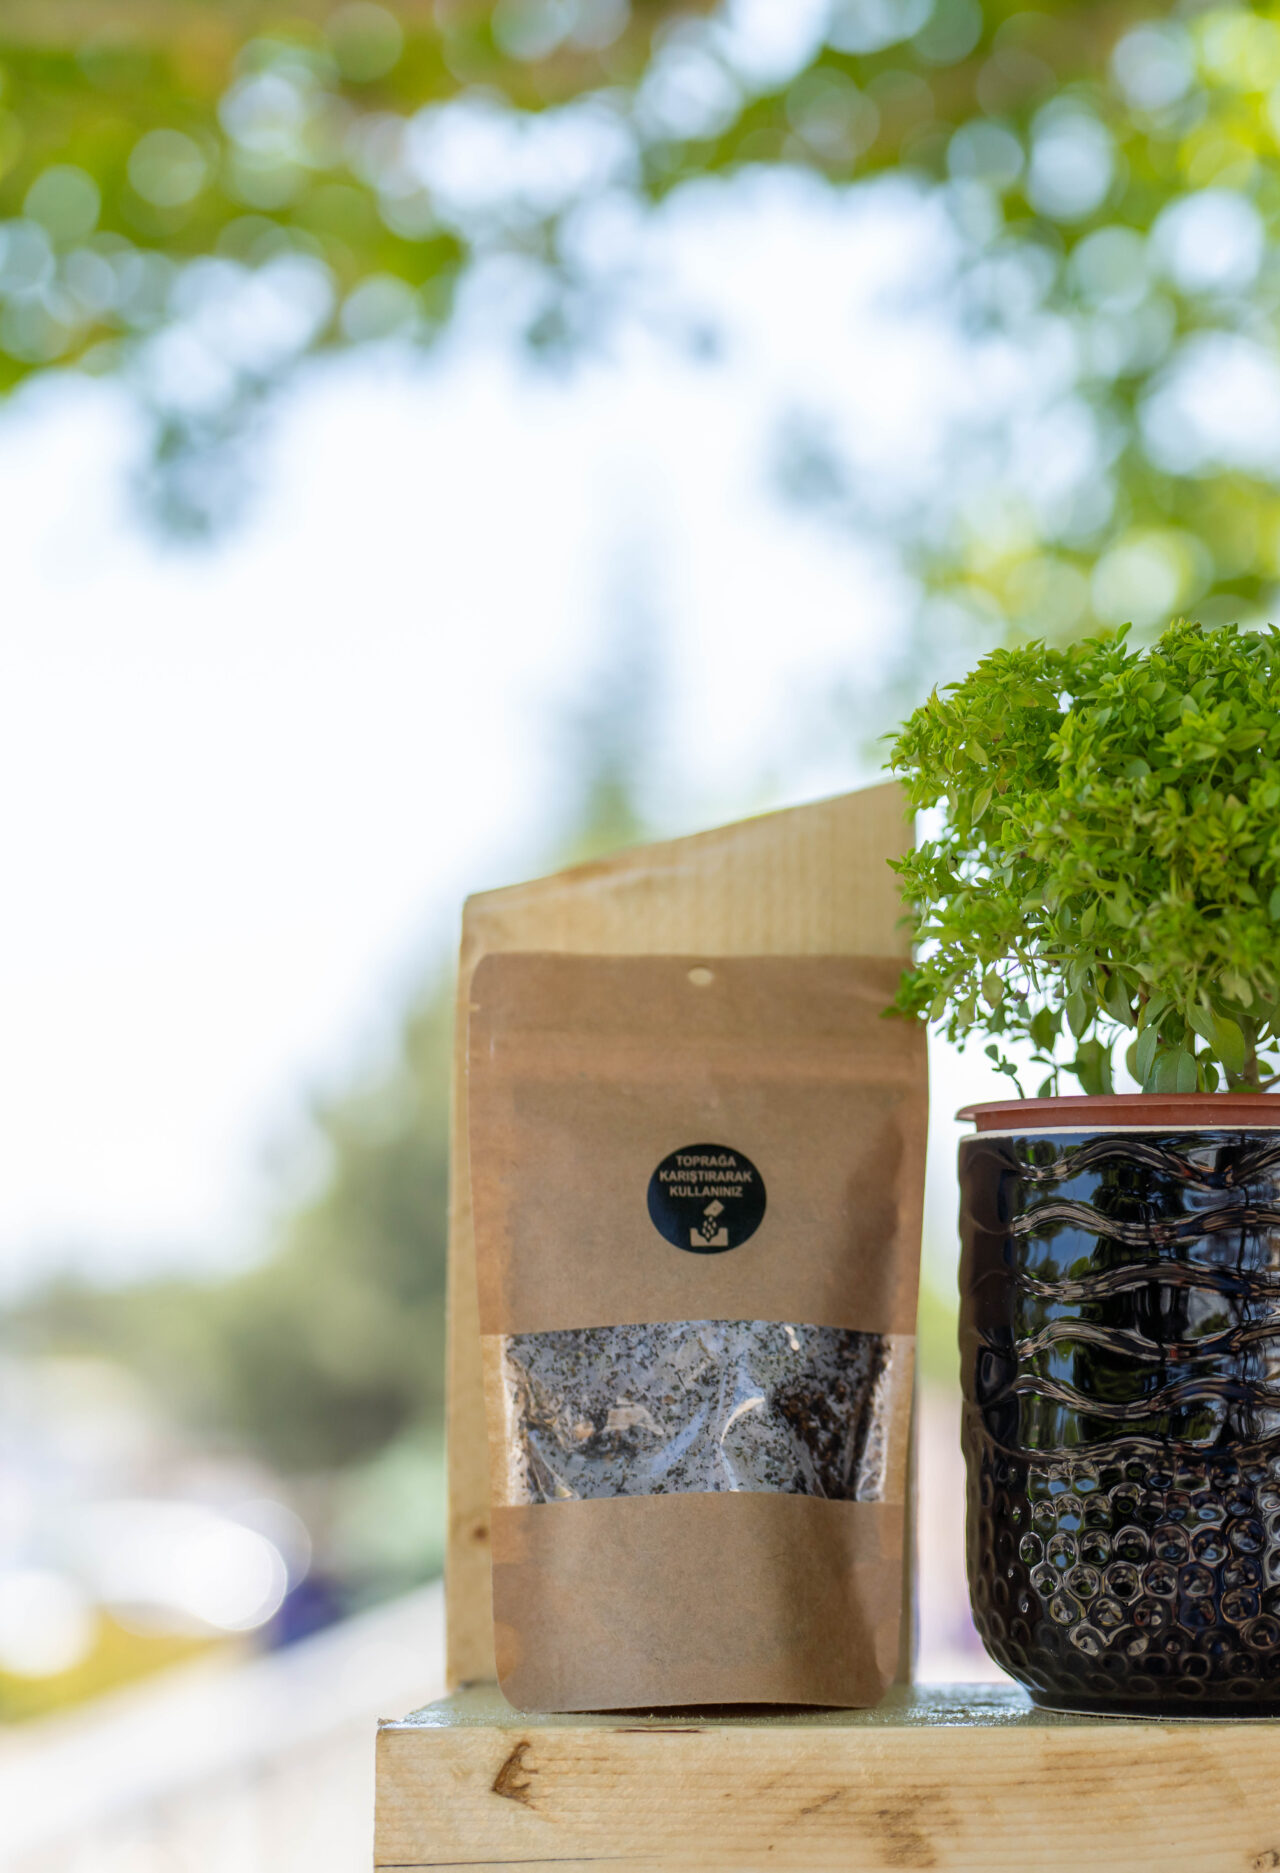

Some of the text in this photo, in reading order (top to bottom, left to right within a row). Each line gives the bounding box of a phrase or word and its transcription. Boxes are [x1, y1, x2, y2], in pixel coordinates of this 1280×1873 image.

[676, 1154, 736, 1167] TOPRAĞA
[660, 1170, 752, 1184] KARIŞTIRARAK
[670, 1186, 743, 1197] KULLANINIZ
